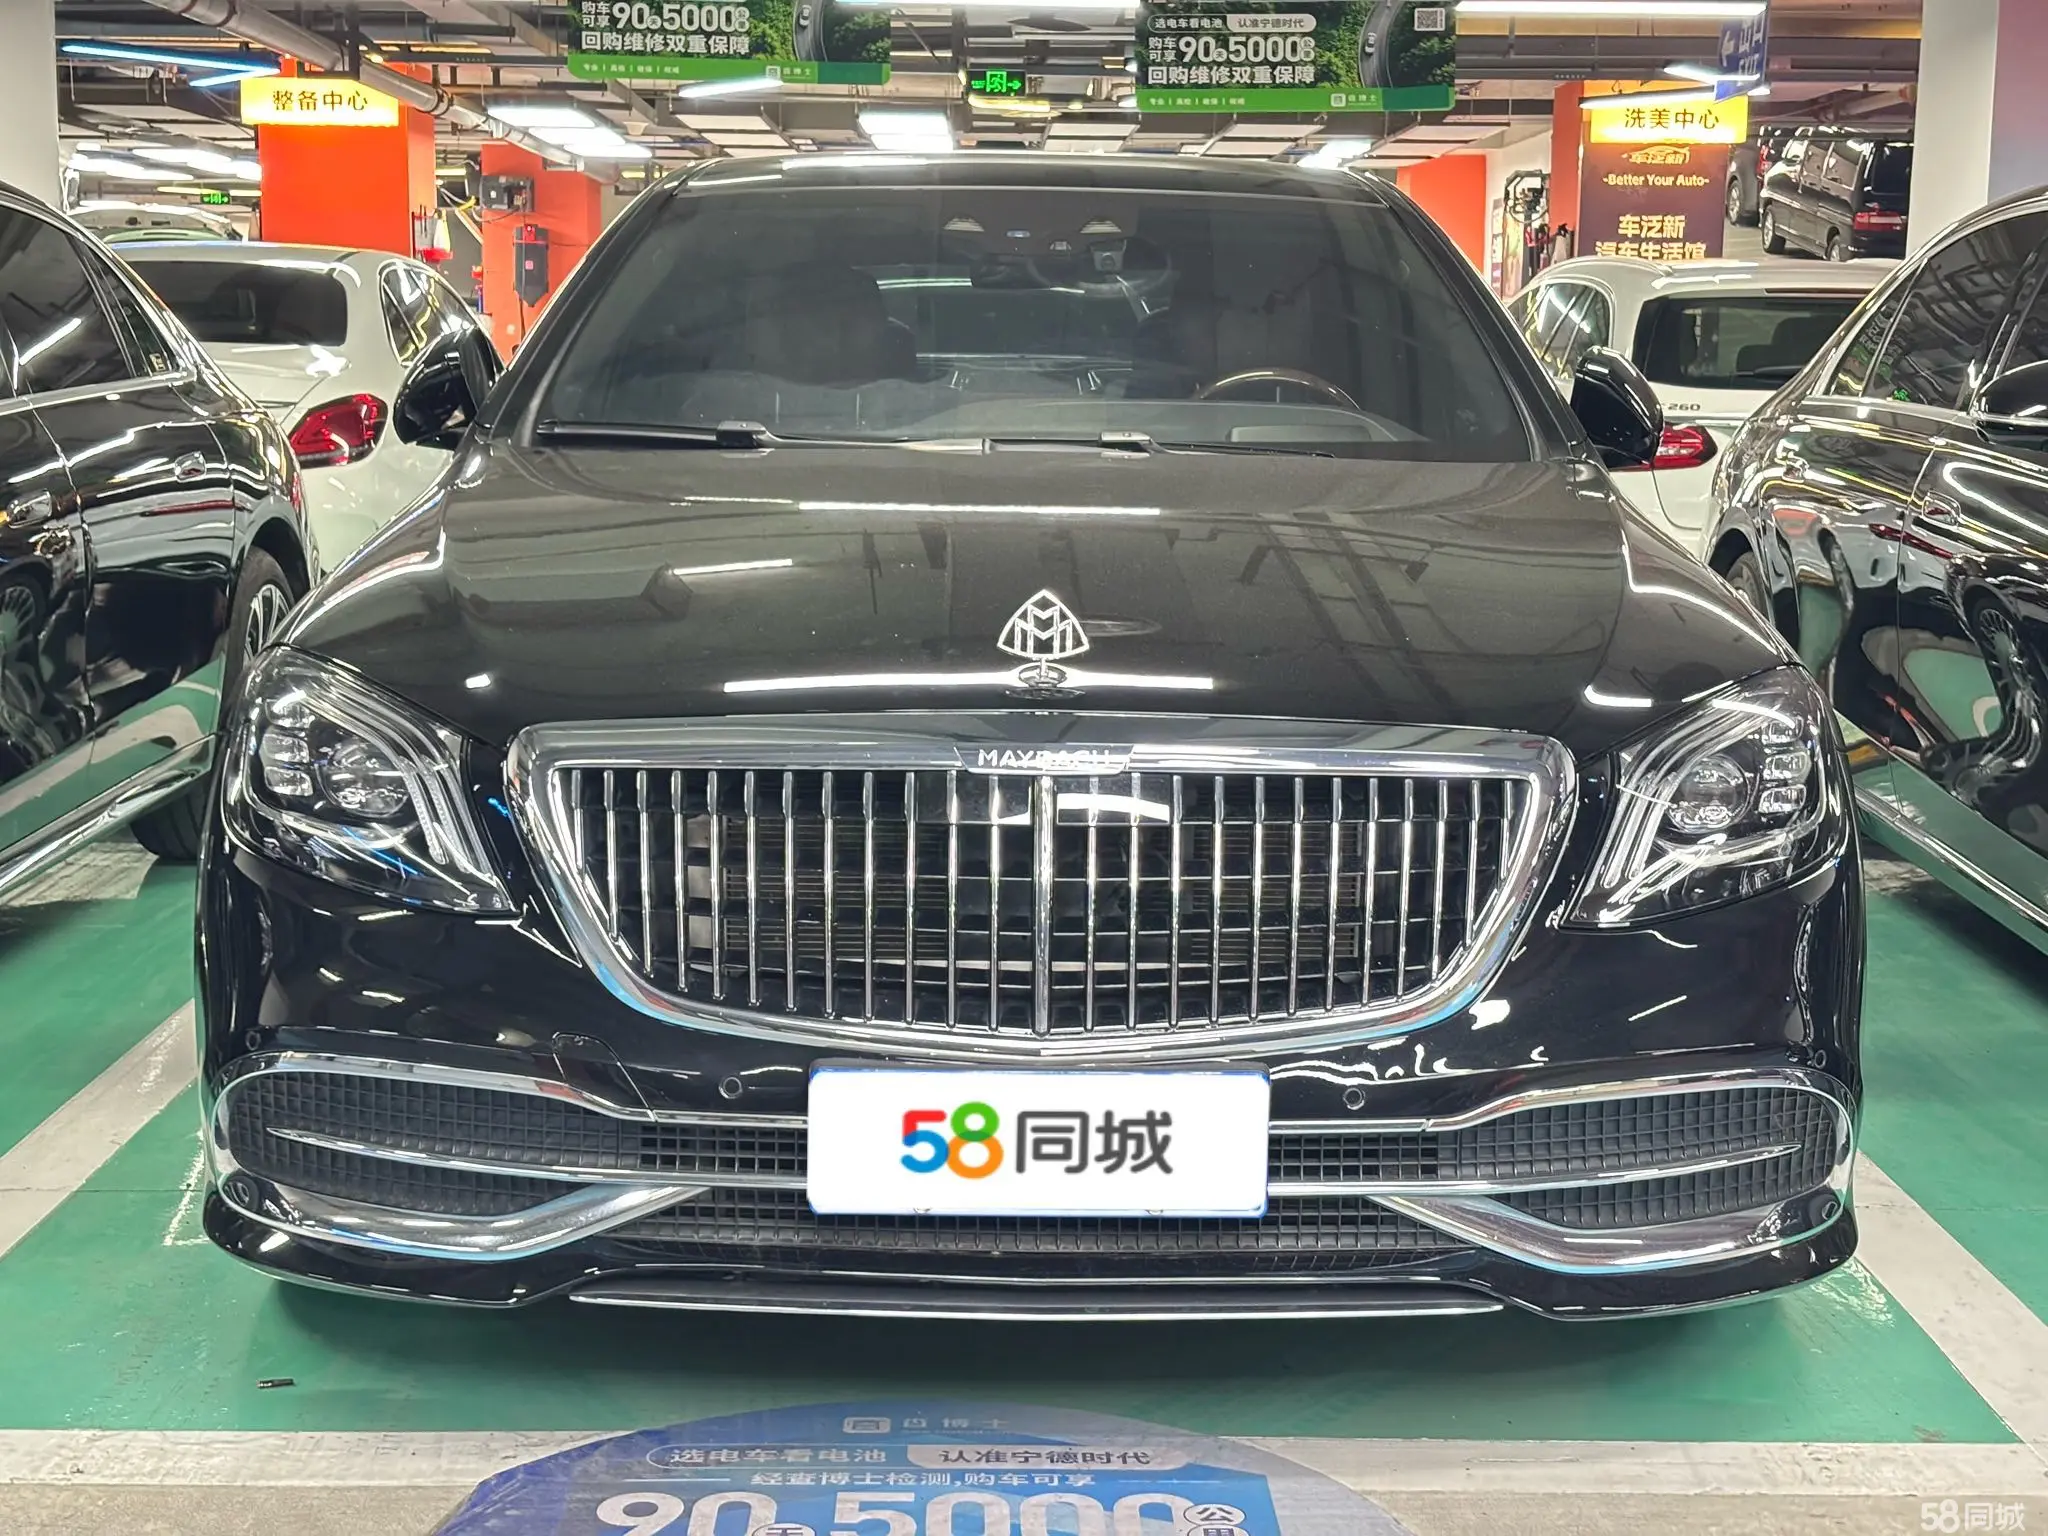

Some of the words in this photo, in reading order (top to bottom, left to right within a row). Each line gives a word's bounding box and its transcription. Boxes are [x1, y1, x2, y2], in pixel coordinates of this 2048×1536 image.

[1155, 17, 1223, 29] 选电车看电池
[1238, 17, 1305, 29] 认准宁德时代
[581, 31, 750, 54] 回购维修双重保障
[1147, 65, 1315, 84] 回购维修双重保障
[272, 89, 369, 112] 整备中心
[1624, 107, 1720, 130] 洗美中心
[1646, 174, 1675, 187] Your
[1617, 214, 1686, 239] 车泛新
[669, 1448, 888, 1464] 选电车看电池
[938, 1449, 1151, 1465] 认准宁德时代
